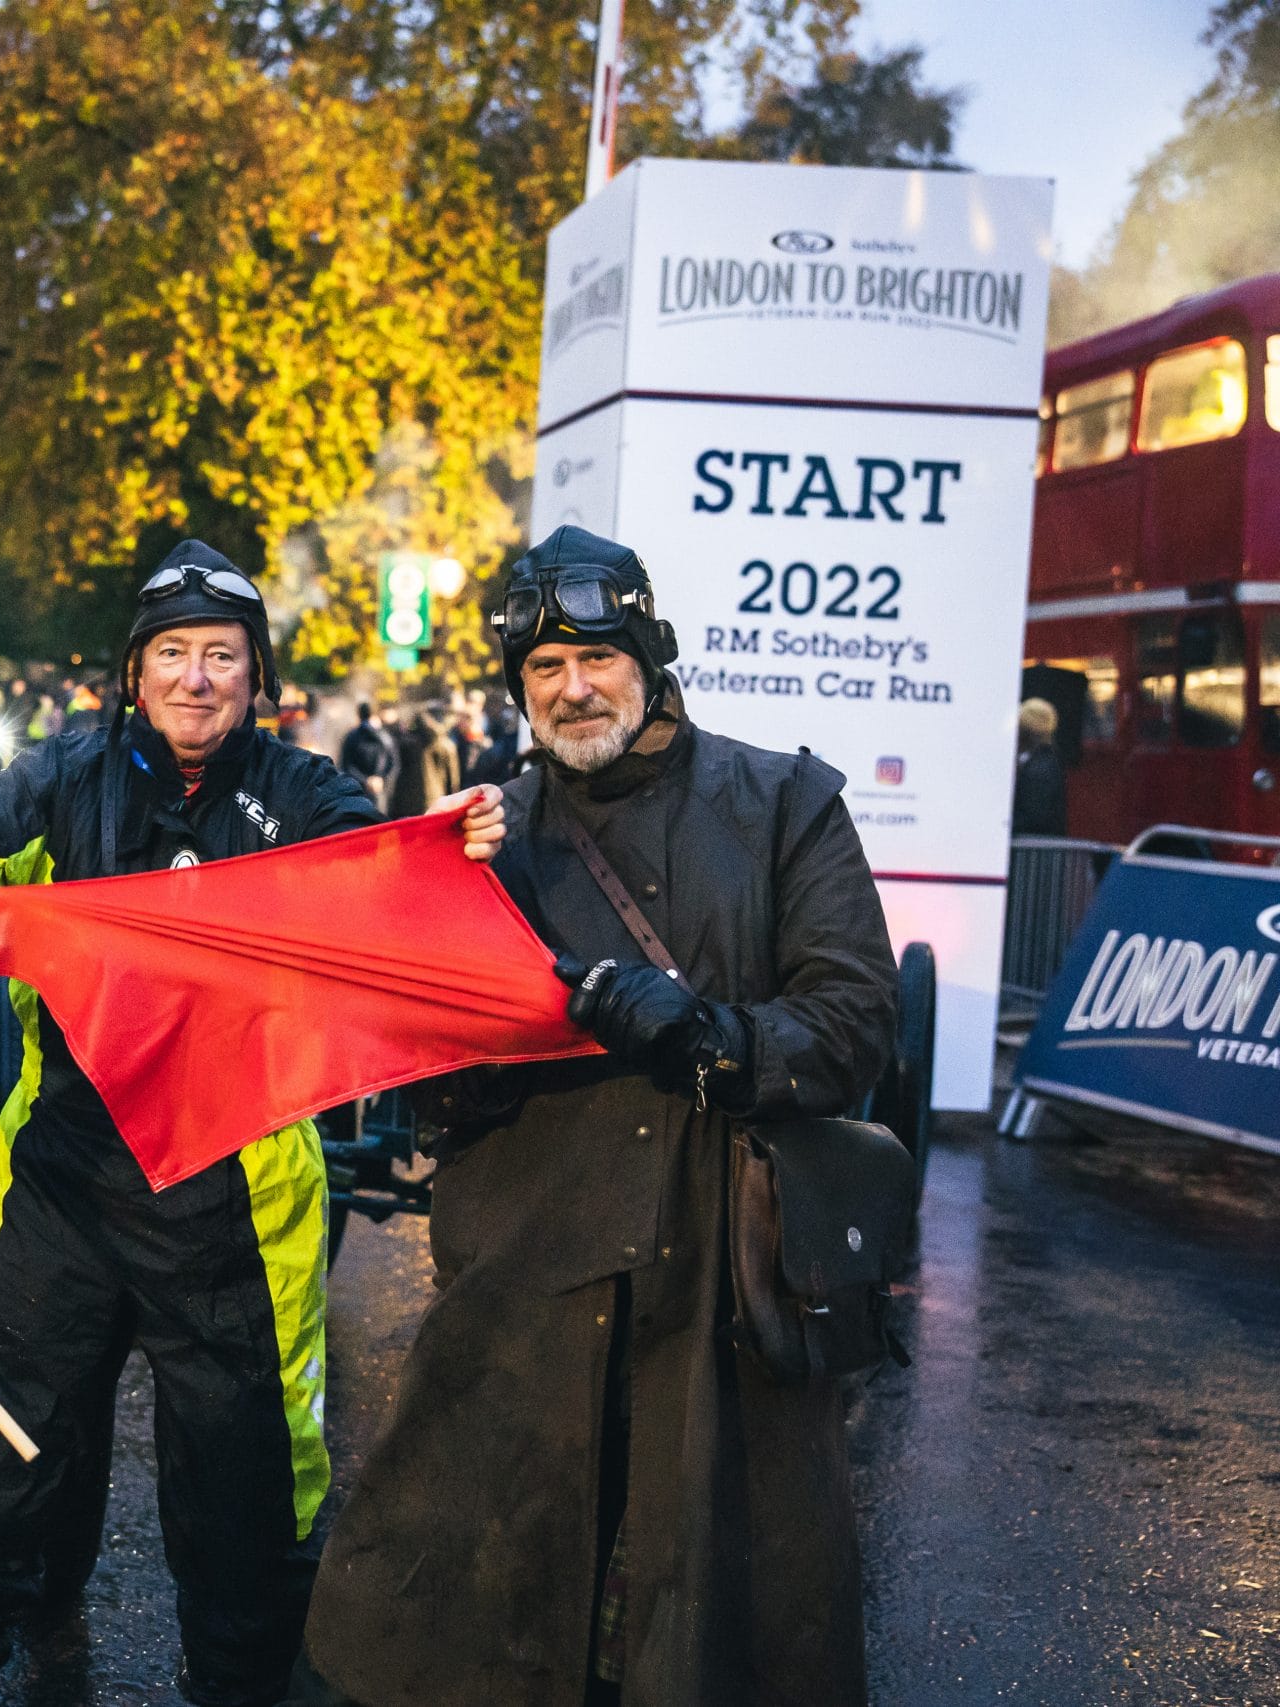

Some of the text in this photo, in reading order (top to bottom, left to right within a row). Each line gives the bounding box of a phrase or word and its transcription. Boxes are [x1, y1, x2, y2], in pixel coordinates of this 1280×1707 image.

[658, 256, 795, 314] LONDON
[805, 262, 845, 305] TO
[855, 264, 1023, 332] BRIGHTON
[746, 309, 816, 321] VETERAN
[823, 309, 853, 320] CAR
[859, 311, 891, 322] RUN
[693, 449, 961, 524] START
[738, 559, 902, 620] 2022
[705, 627, 929, 667] RM Sotheby's
[677, 665, 952, 703] Veteran Car Run
[1064, 929, 1278, 1034] LONDON
